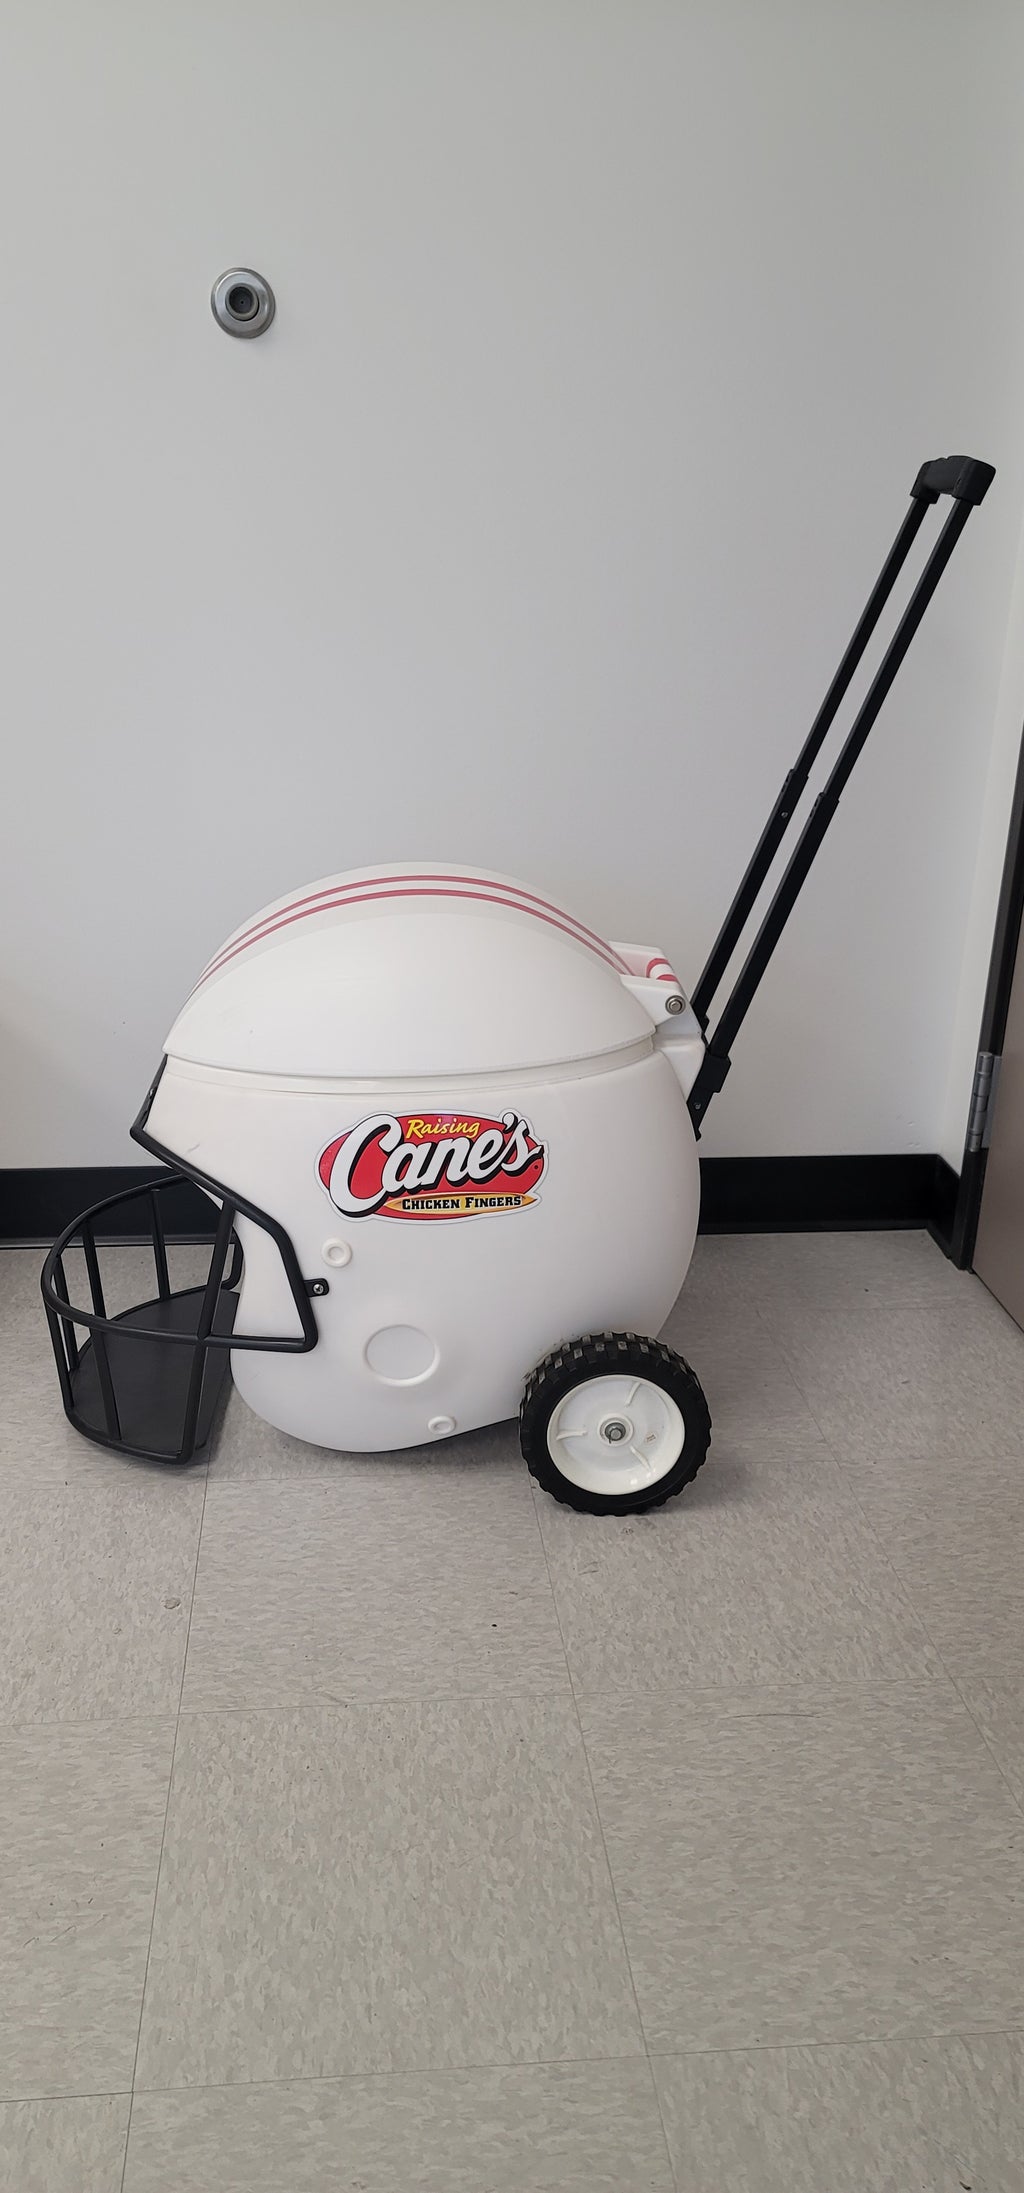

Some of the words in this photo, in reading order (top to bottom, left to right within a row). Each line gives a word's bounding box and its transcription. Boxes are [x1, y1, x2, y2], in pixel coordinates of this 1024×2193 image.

[405, 1118, 480, 1139] Raising
[329, 1112, 543, 1217] Cane's
[402, 1199, 460, 1210] CHICKEN
[465, 1195, 522, 1209] FINGERS
